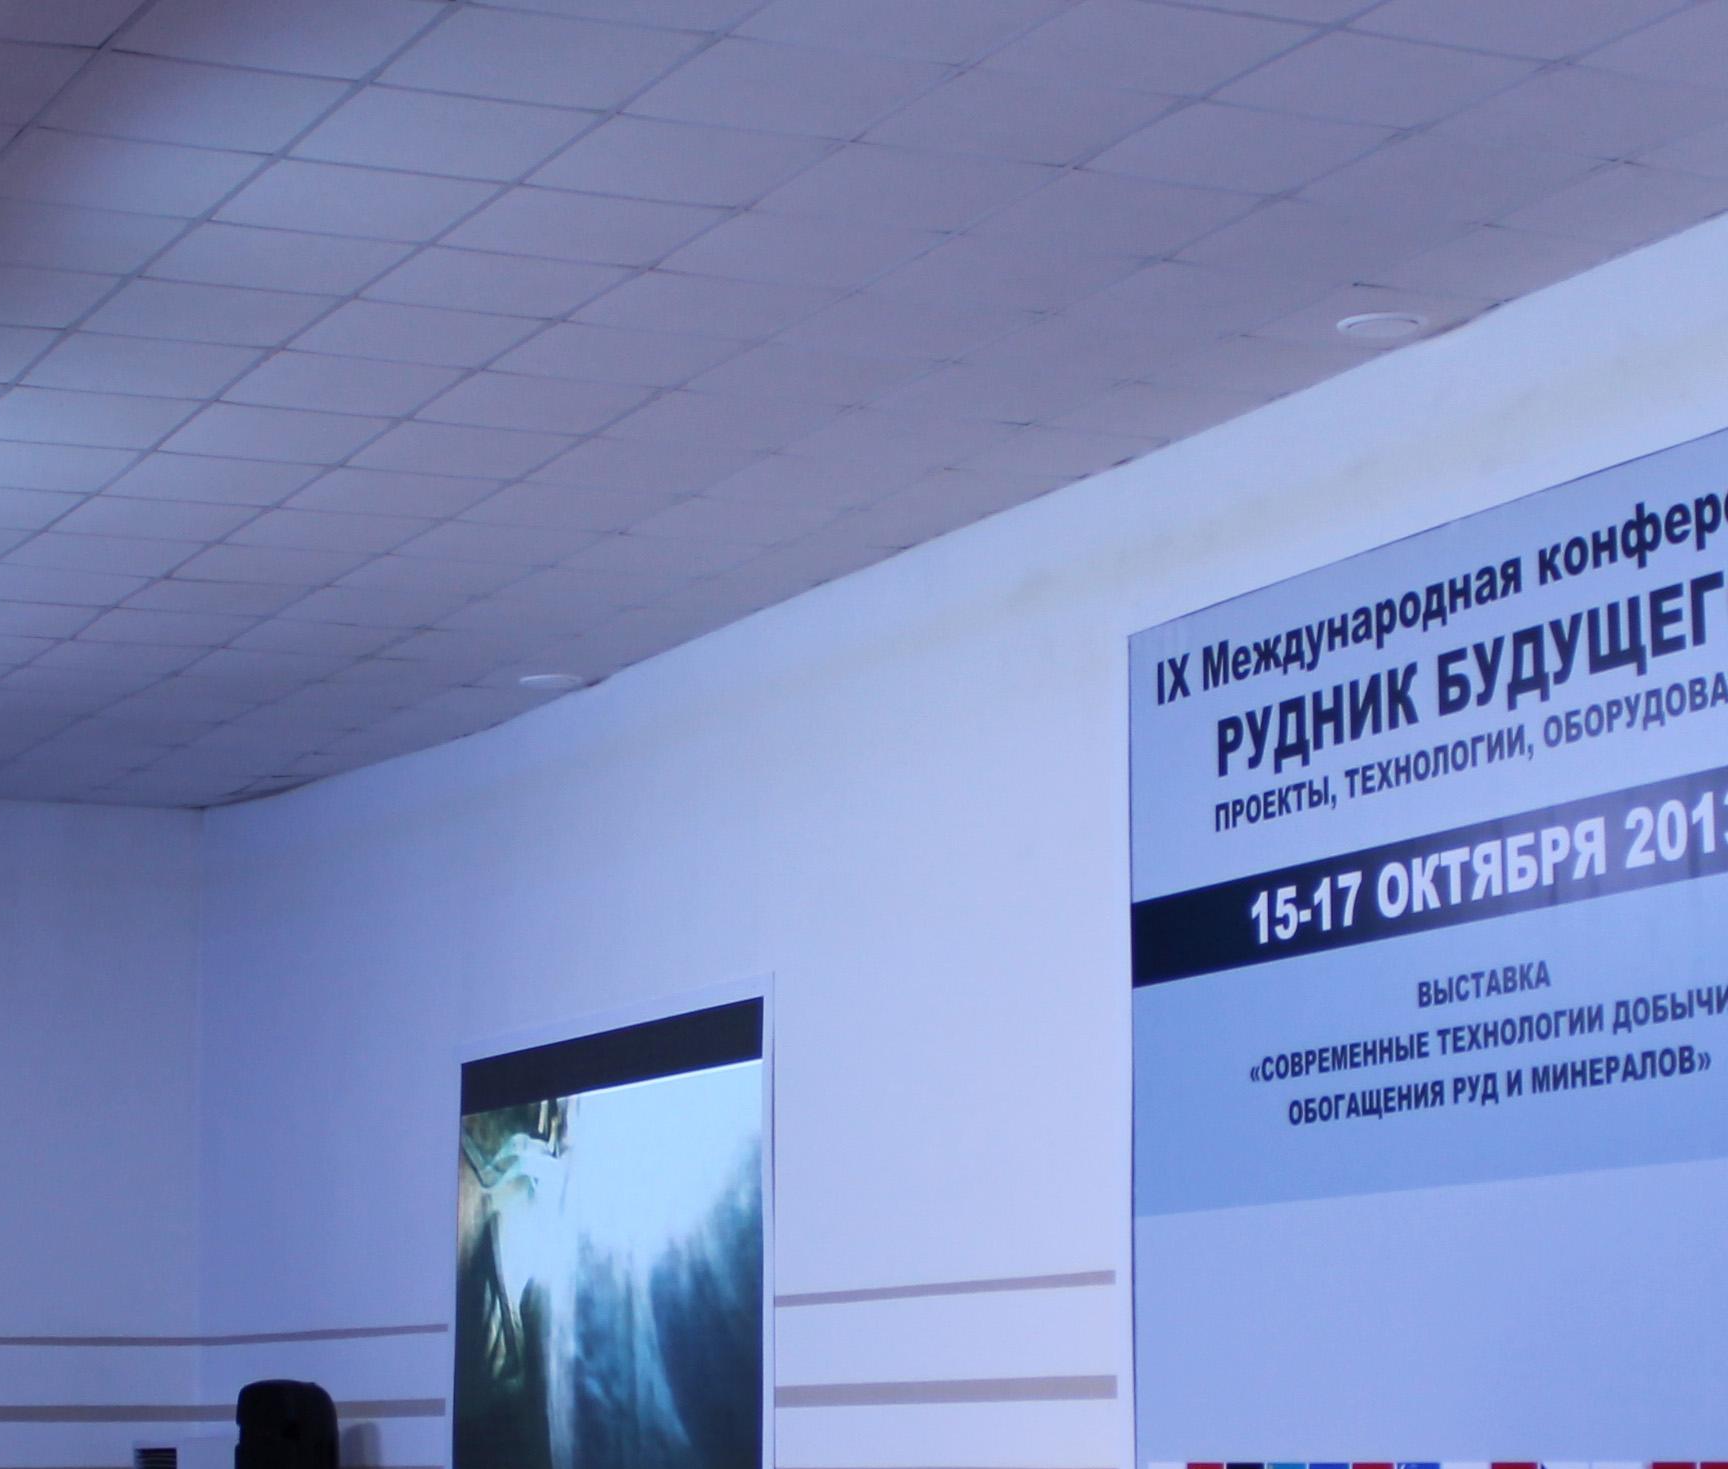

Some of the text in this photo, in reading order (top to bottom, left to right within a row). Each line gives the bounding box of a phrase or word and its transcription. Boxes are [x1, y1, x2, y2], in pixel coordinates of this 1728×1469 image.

[1157, 652, 1191, 705] IX
[1202, 556, 1522, 691] Международная
[1217, 661, 1419, 778] РУДНИК
[1215, 775, 1337, 832] ПРОЕКТЫ,
[1344, 724, 1534, 798] ТЕХНОЛОГИИ,
[1250, 870, 1362, 944] 15-17
[1377, 816, 1607, 919] ОКТЯБРЯ
[1417, 960, 1551, 1008] ВЫСТАВКА
[1250, 1031, 1430, 1082] «СОВРЕМЕННЫЕ
[1437, 1003, 1604, 1055] ТЕХНОЛОГИИ
[1289, 1045, 1712, 1126] ОБОГАЩЕНИЯ РУД И МИНЕРАЛОВ»
